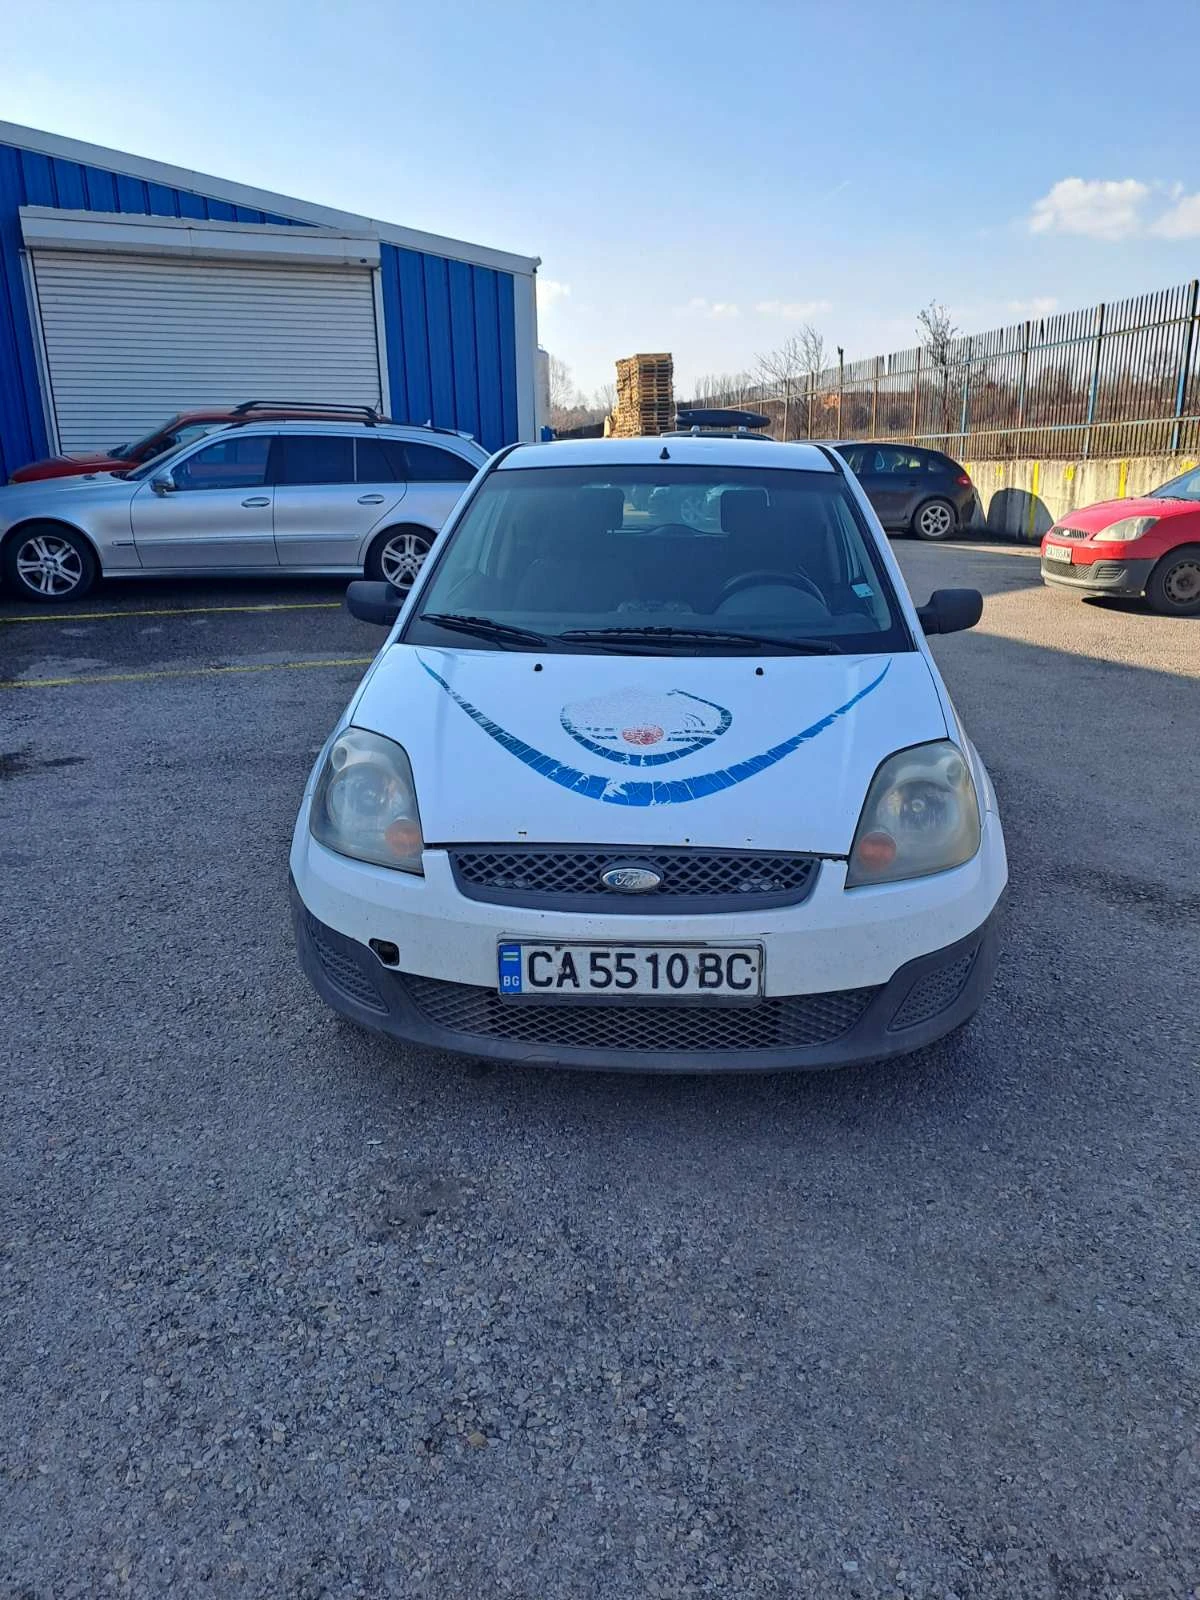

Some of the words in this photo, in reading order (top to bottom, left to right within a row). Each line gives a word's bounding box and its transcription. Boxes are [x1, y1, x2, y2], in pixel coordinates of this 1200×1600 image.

[503, 975, 520, 987] BG
[528, 951, 580, 988] CA
[589, 952, 689, 989] 5510
[698, 953, 752, 990] BC
